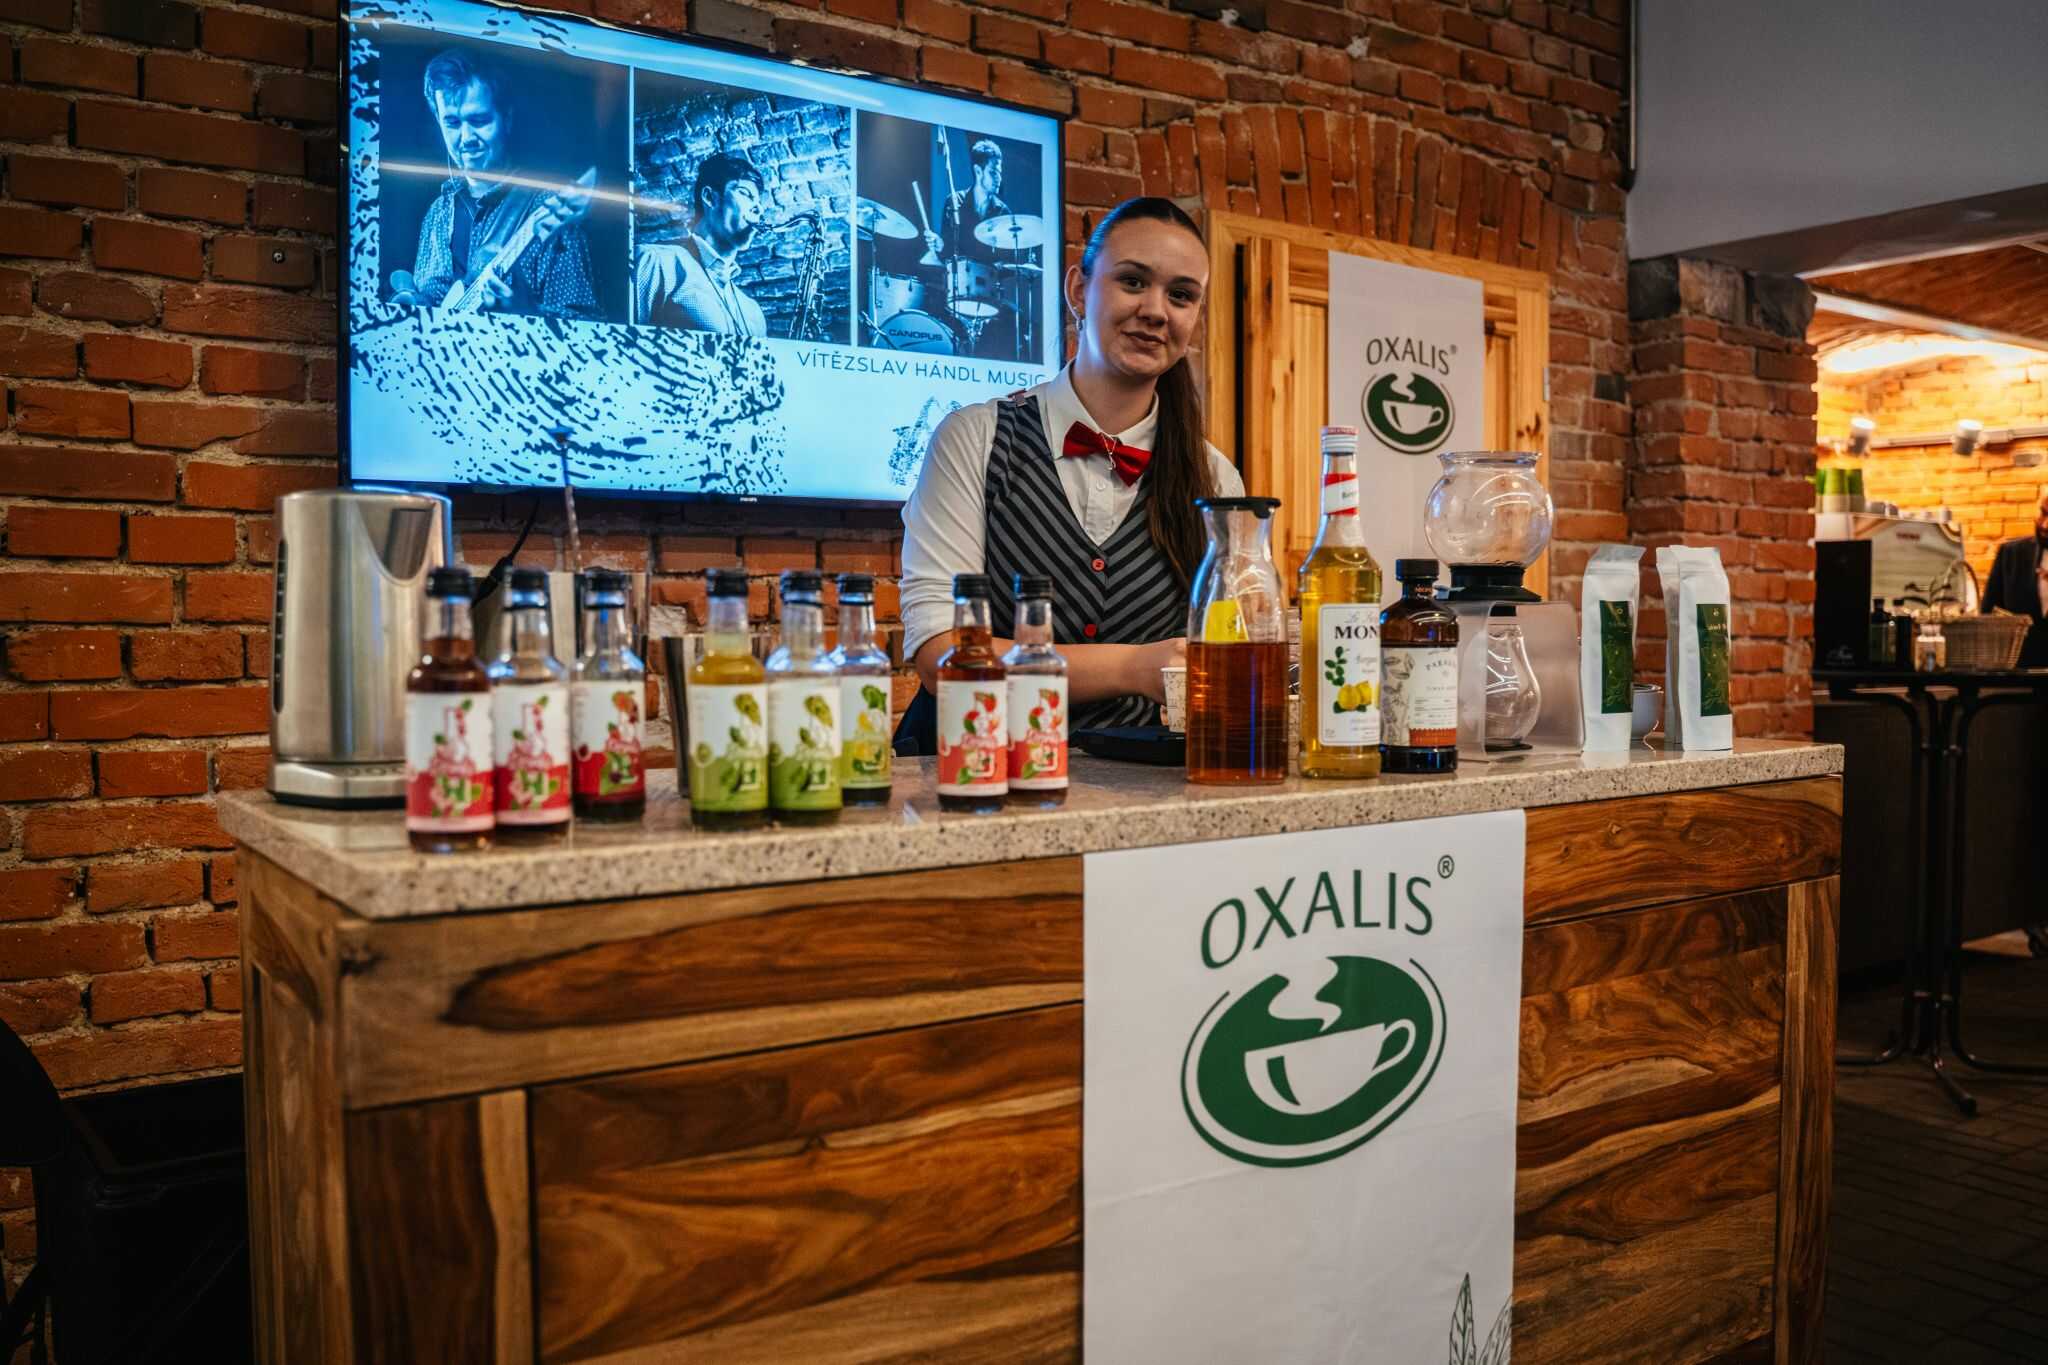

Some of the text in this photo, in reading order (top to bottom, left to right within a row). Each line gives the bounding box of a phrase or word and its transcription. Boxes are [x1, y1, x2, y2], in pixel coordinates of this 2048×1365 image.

[889, 329, 943, 341] CANOPUS
[797, 348, 908, 375] VÍTĚZSLAV
[915, 359, 981, 383] HÁNDL
